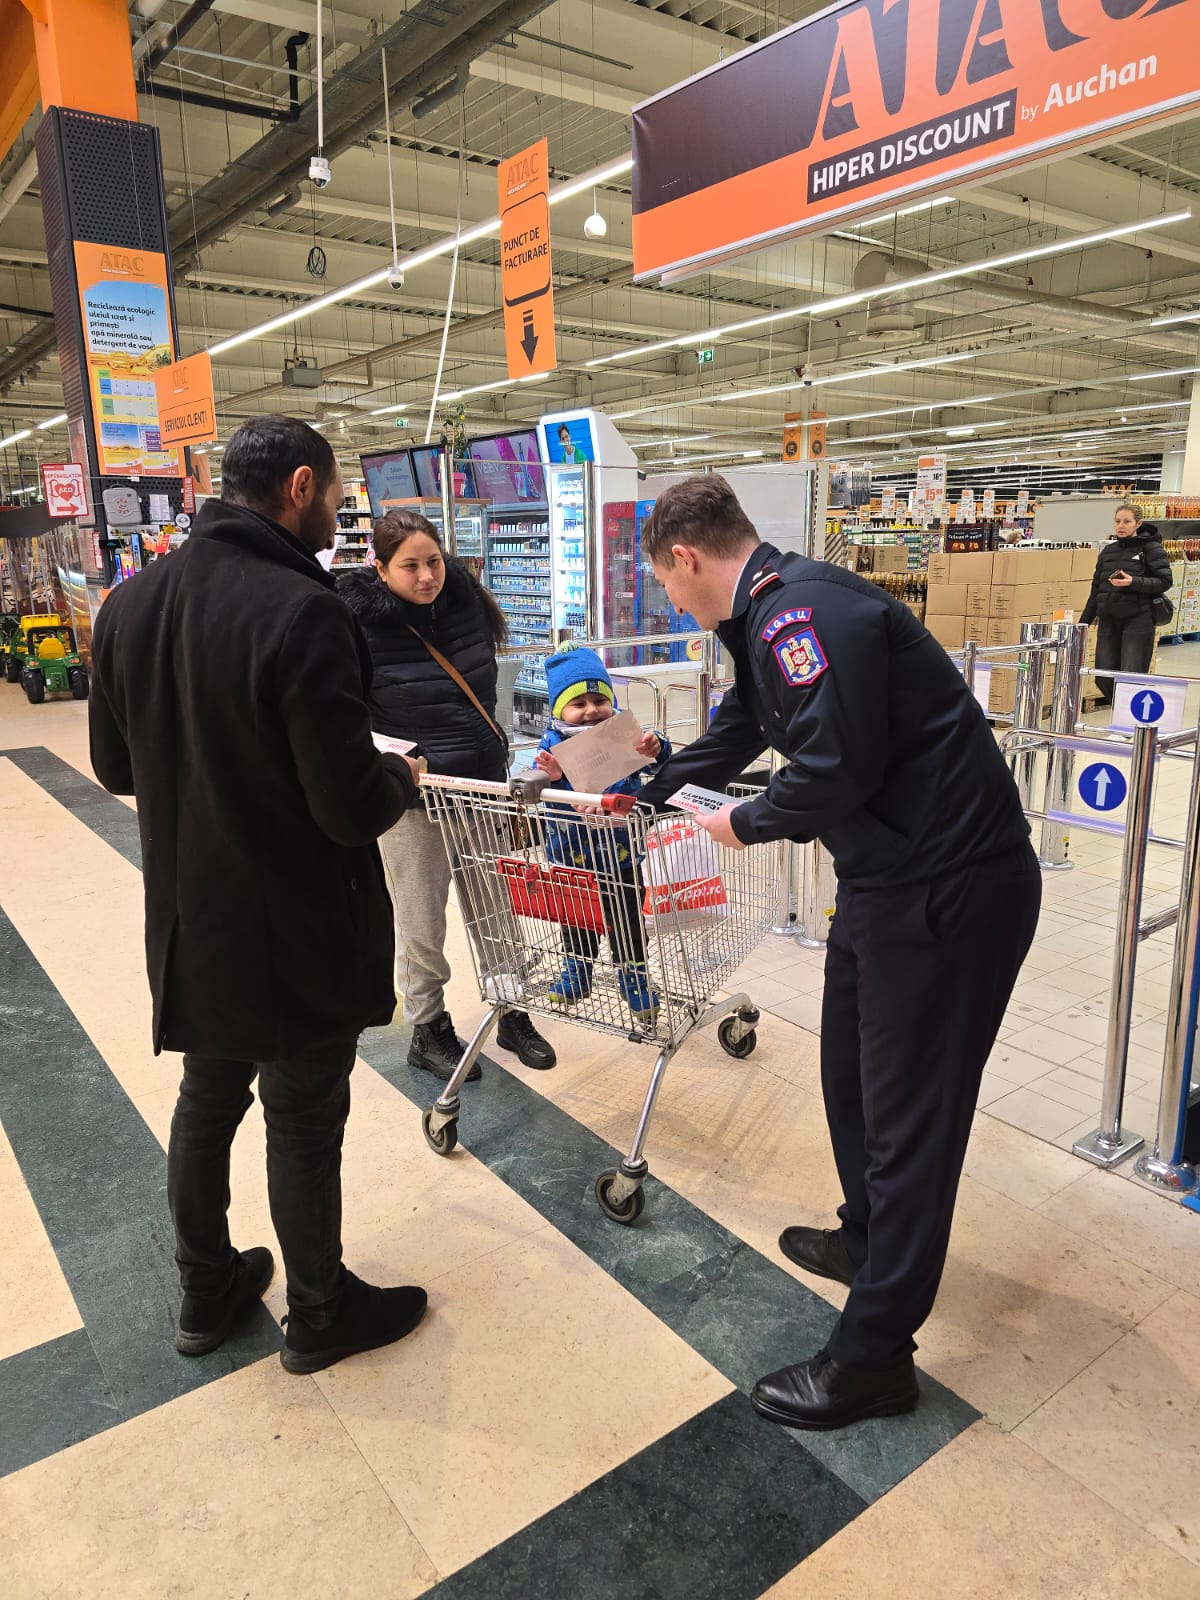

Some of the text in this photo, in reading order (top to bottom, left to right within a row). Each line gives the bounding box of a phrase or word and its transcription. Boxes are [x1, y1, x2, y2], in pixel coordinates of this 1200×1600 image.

[812, 54, 1158, 195] HIPER DISCOUNT by Auchan
[507, 152, 539, 188] ATAC
[504, 226, 540, 253] PUNCT DE
[100, 252, 144, 271] ATAC
[504, 243, 548, 271] FACTURARE
[87, 301, 156, 316] Reciclează ecologic
[89, 311, 110, 319] uleiul
[92, 338, 127, 348] detergent
